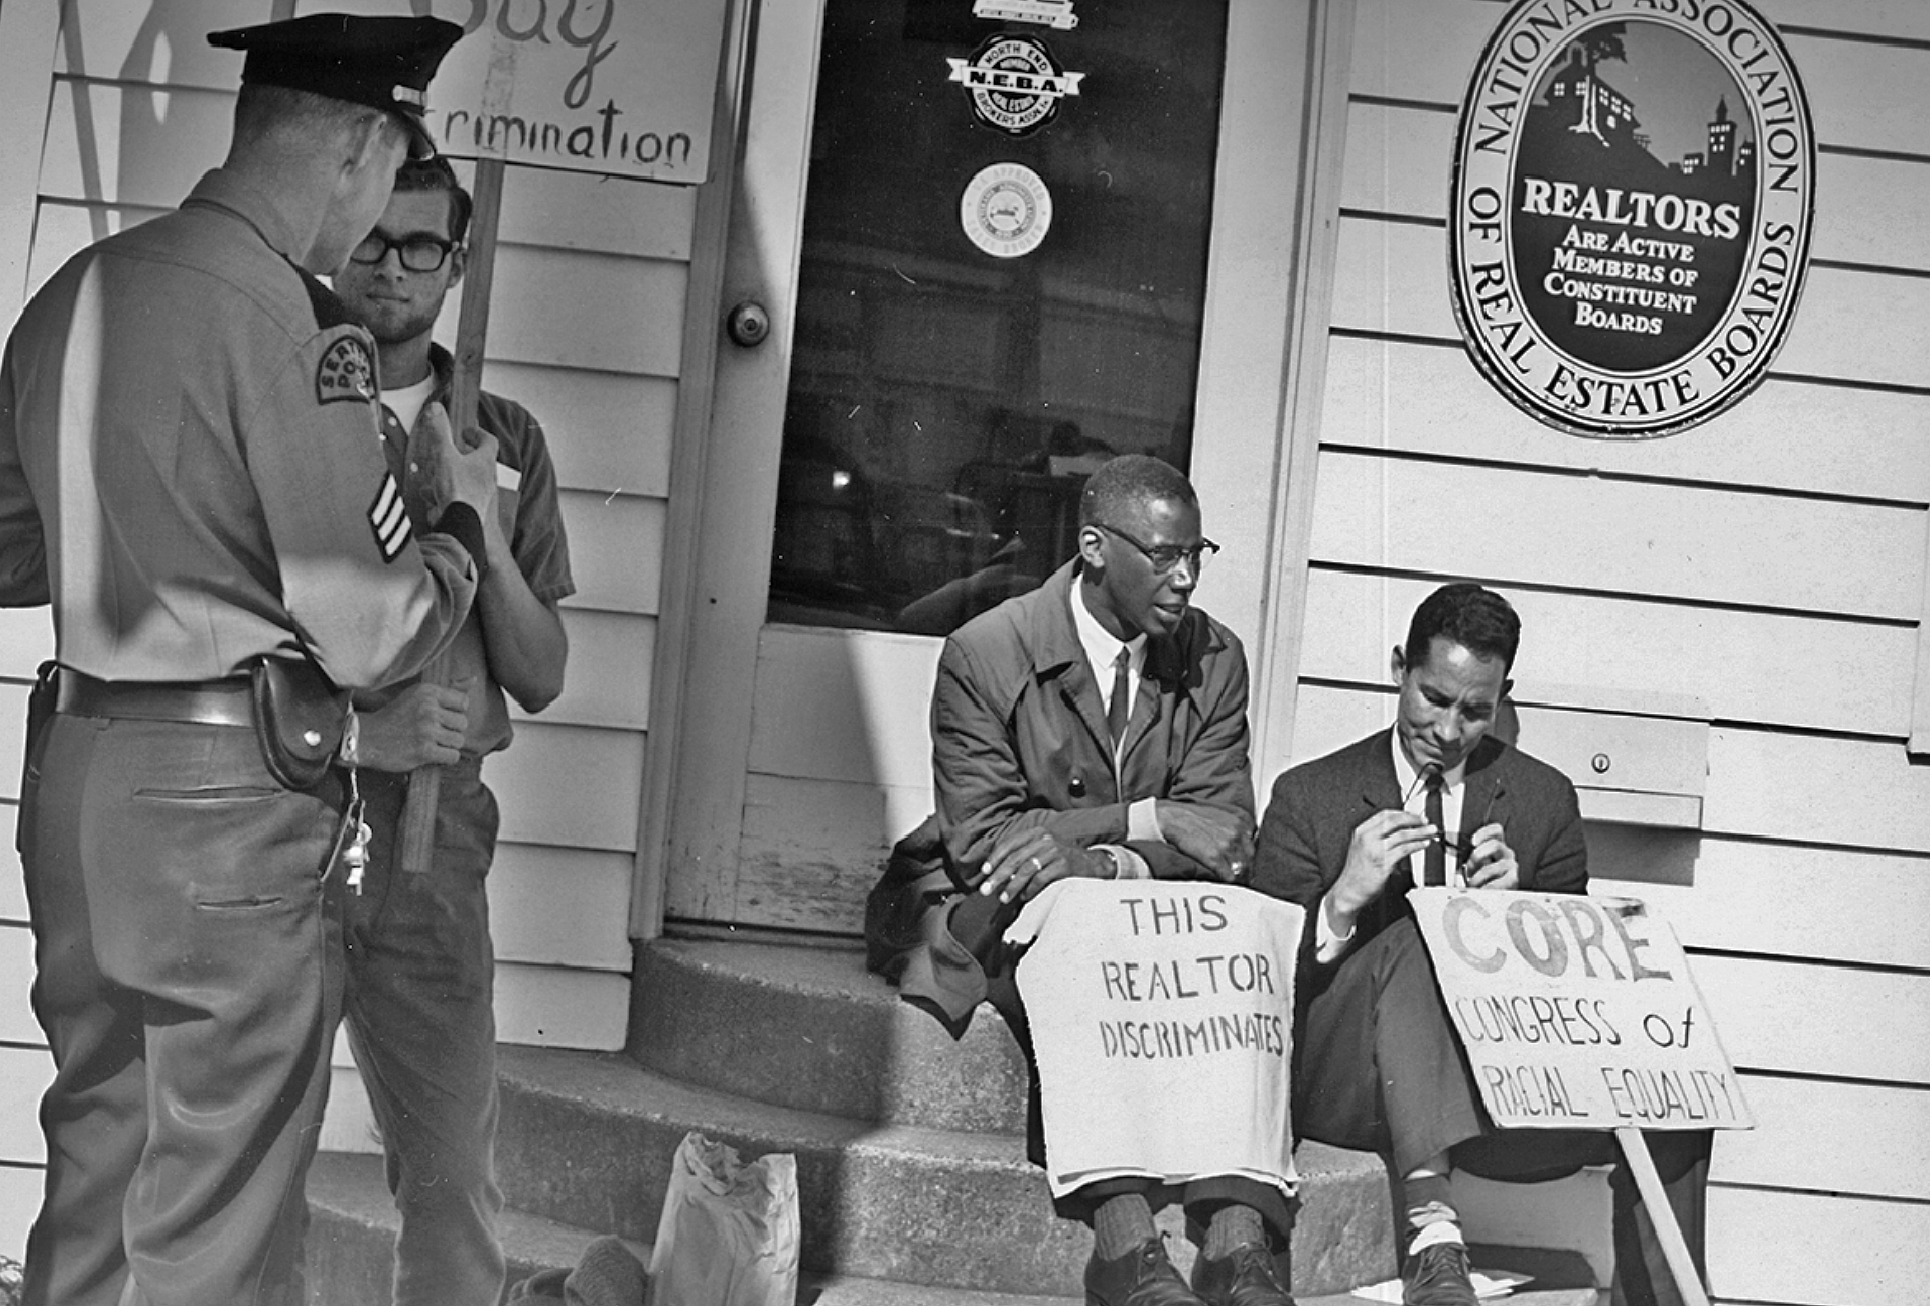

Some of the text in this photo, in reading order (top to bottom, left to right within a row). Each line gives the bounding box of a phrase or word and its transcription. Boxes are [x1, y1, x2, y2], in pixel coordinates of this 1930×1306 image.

[1633, 0, 1799, 193] SOCIATION
[424, 98, 691, 165] rimination
[1521, 177, 1741, 240] REALTORS
[1552, 248, 1664, 283] MEMBERS
[1468, 186, 1796, 416] OF REAL ESTATE BOARDS
[1543, 272, 1698, 316] CONSTITUENT
[1574, 301, 1664, 336] BOARDS
[1119, 894, 1229, 936] THIS
[1442, 896, 1674, 982] CORE
[1101, 953, 1275, 1002] REALTOR
[1100, 1012, 1284, 1060] DISCRIMINATES
[1454, 996, 1622, 1046] CONGRESS
[1481, 1065, 1737, 1122] RACIAL EQUALITY
